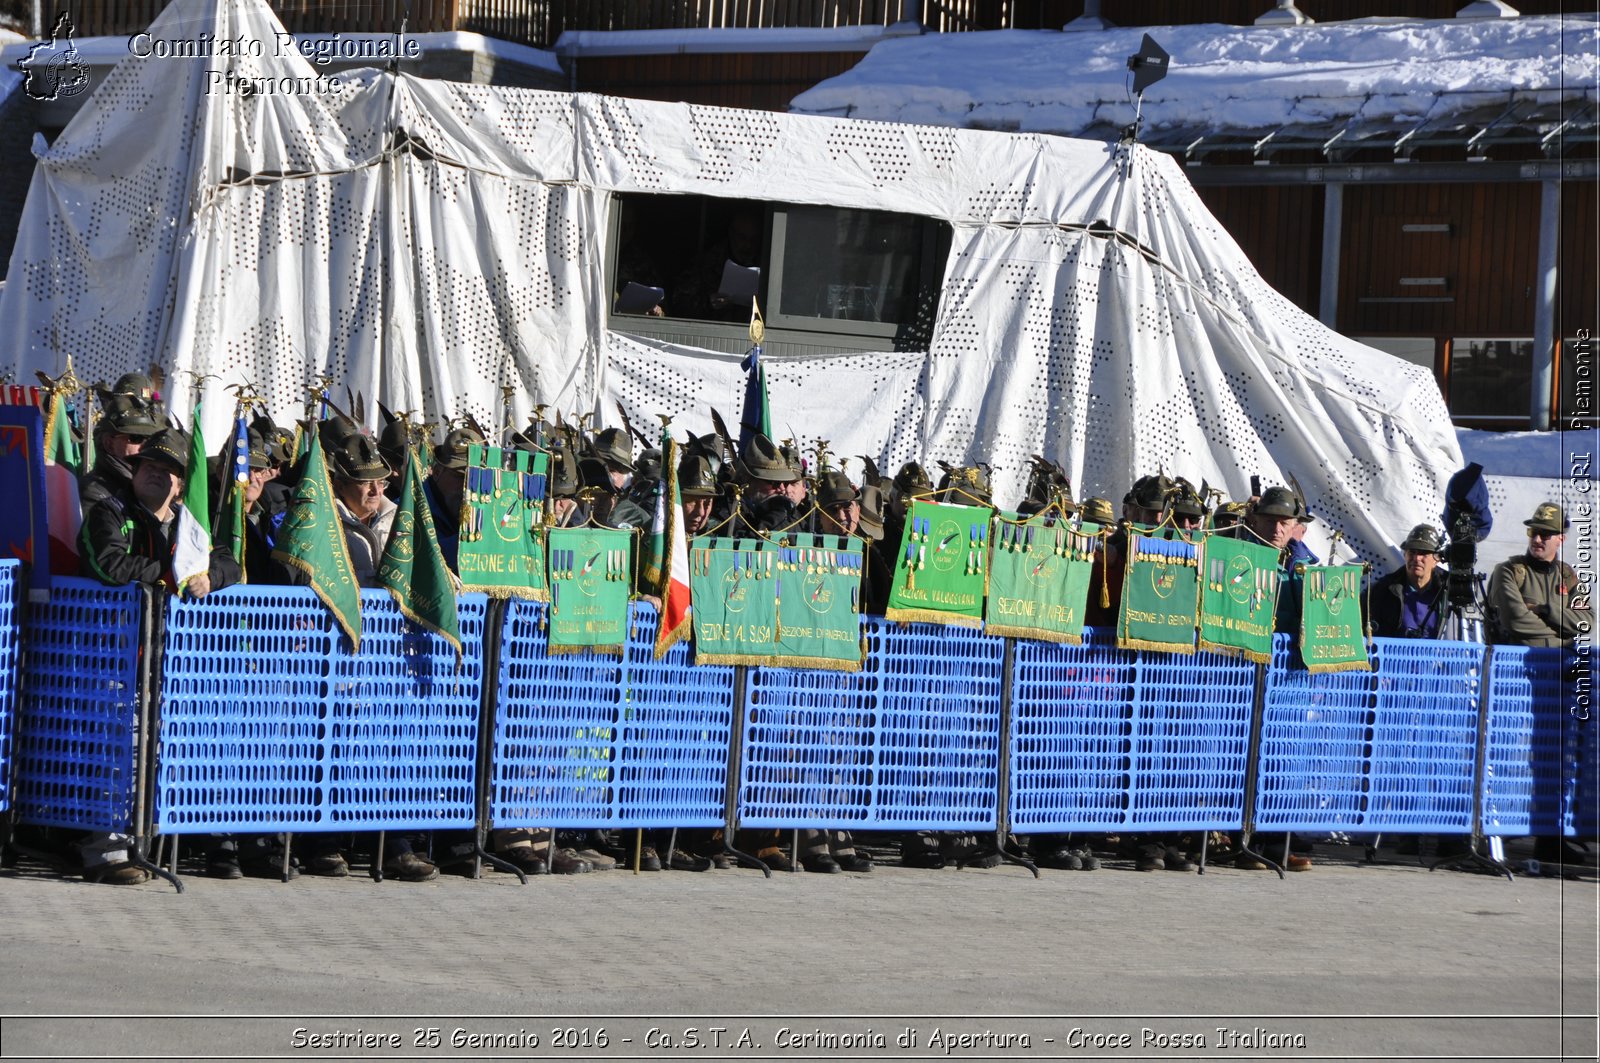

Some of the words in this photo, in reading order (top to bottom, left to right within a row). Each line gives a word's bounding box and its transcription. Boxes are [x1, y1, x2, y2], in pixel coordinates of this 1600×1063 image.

[460, 552, 505, 573] SEZIONE
[508, 555, 518, 573] di
[781, 625, 813, 639] SEZIONE
